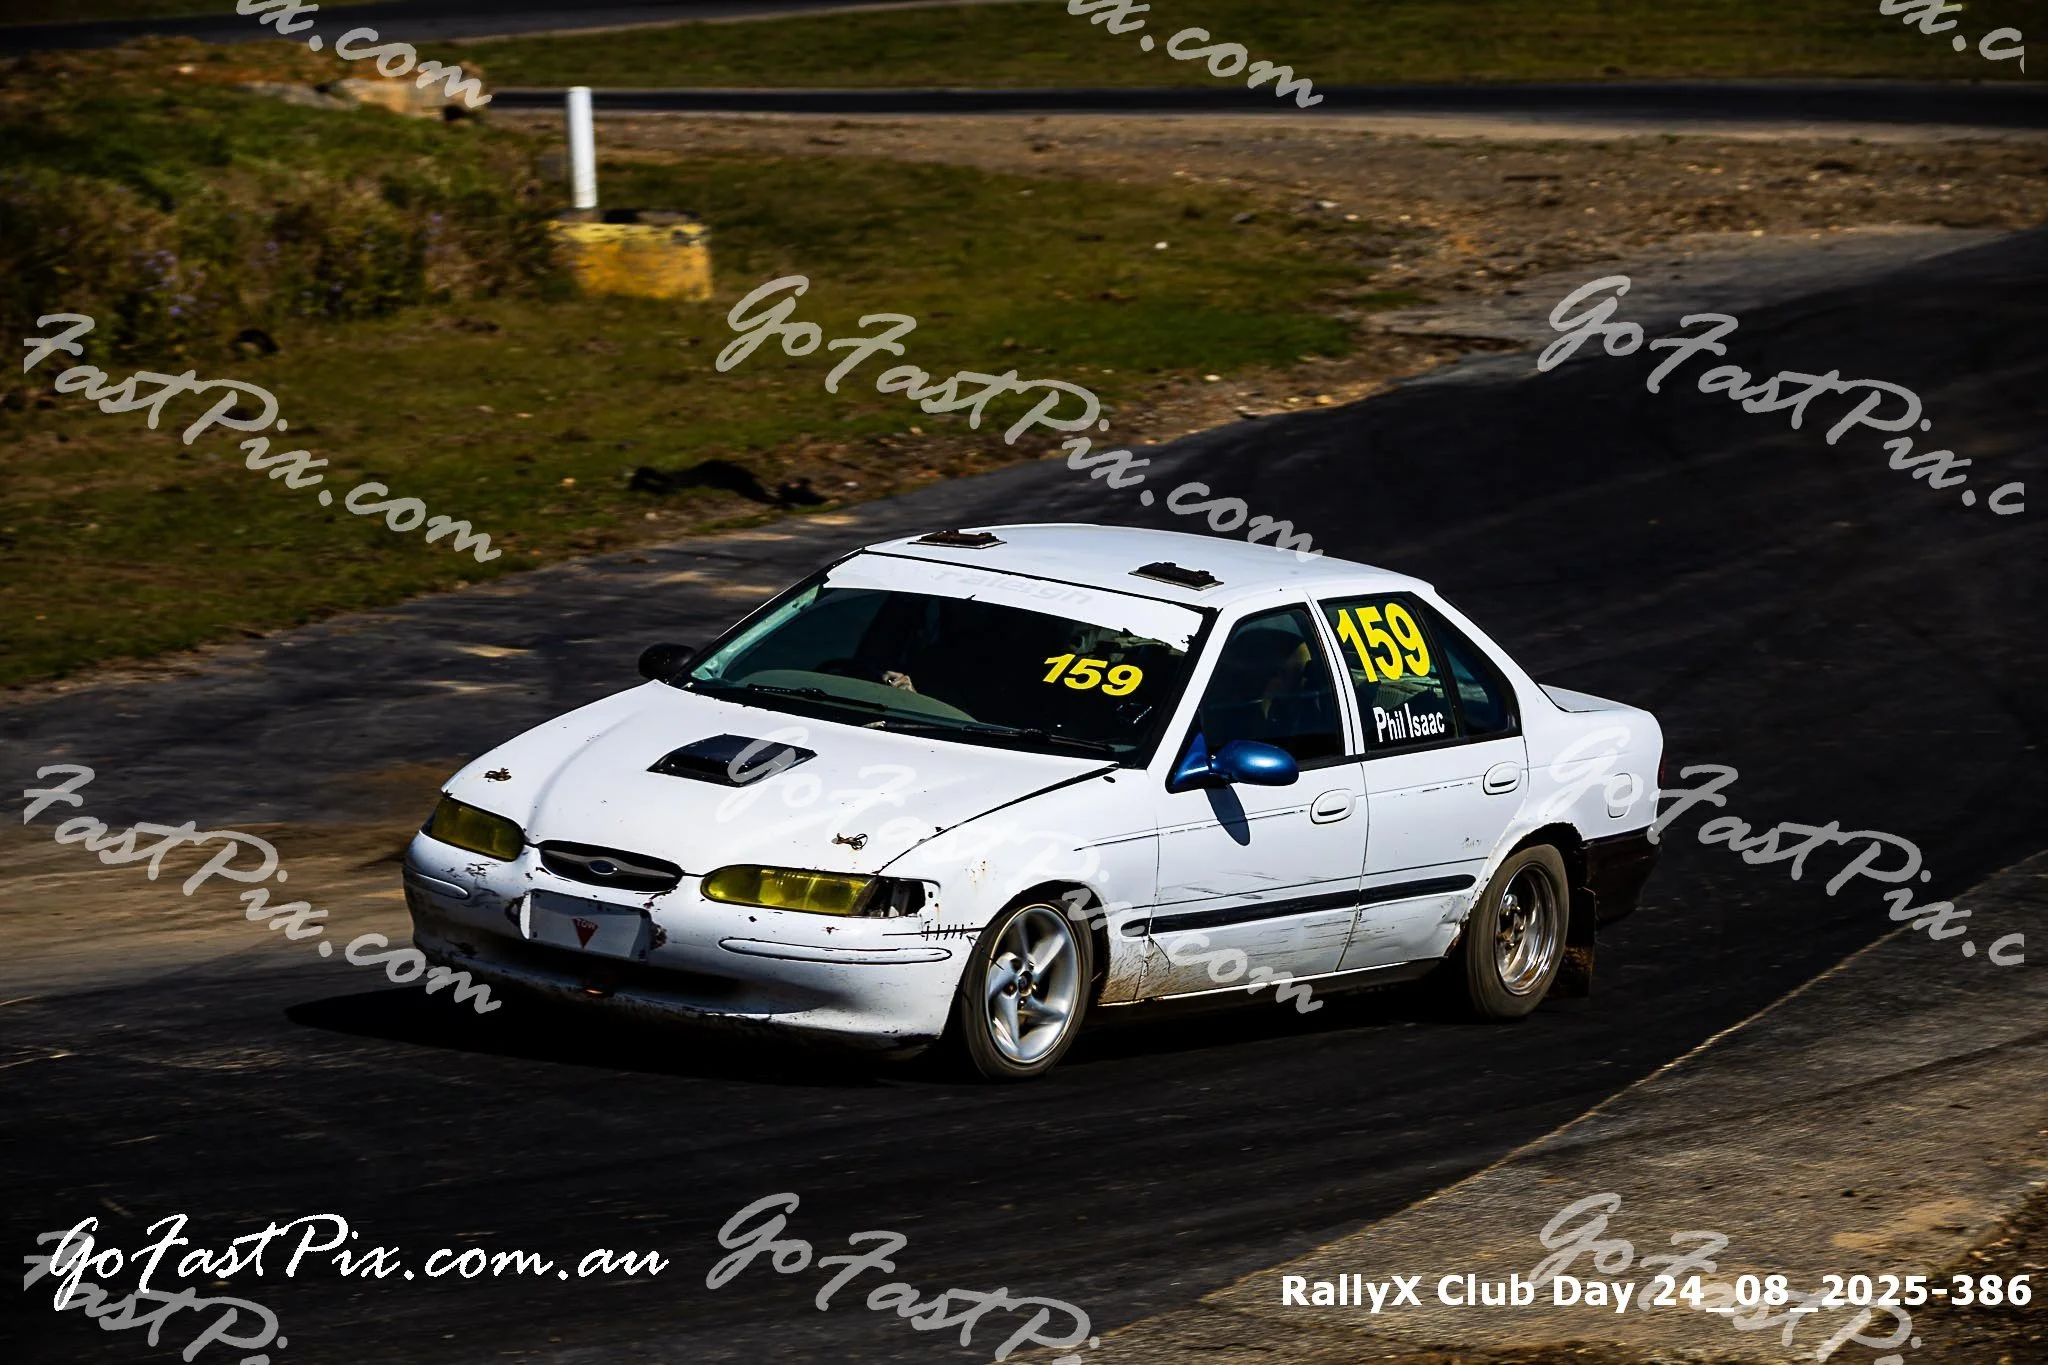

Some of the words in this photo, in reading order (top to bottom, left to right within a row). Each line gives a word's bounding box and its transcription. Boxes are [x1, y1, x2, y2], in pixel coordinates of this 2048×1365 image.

[1336, 602, 1431, 683] 159
[1042, 653, 1144, 696] 159
[1373, 705, 1406, 743] Phil
[1404, 703, 1446, 738] Isaac
